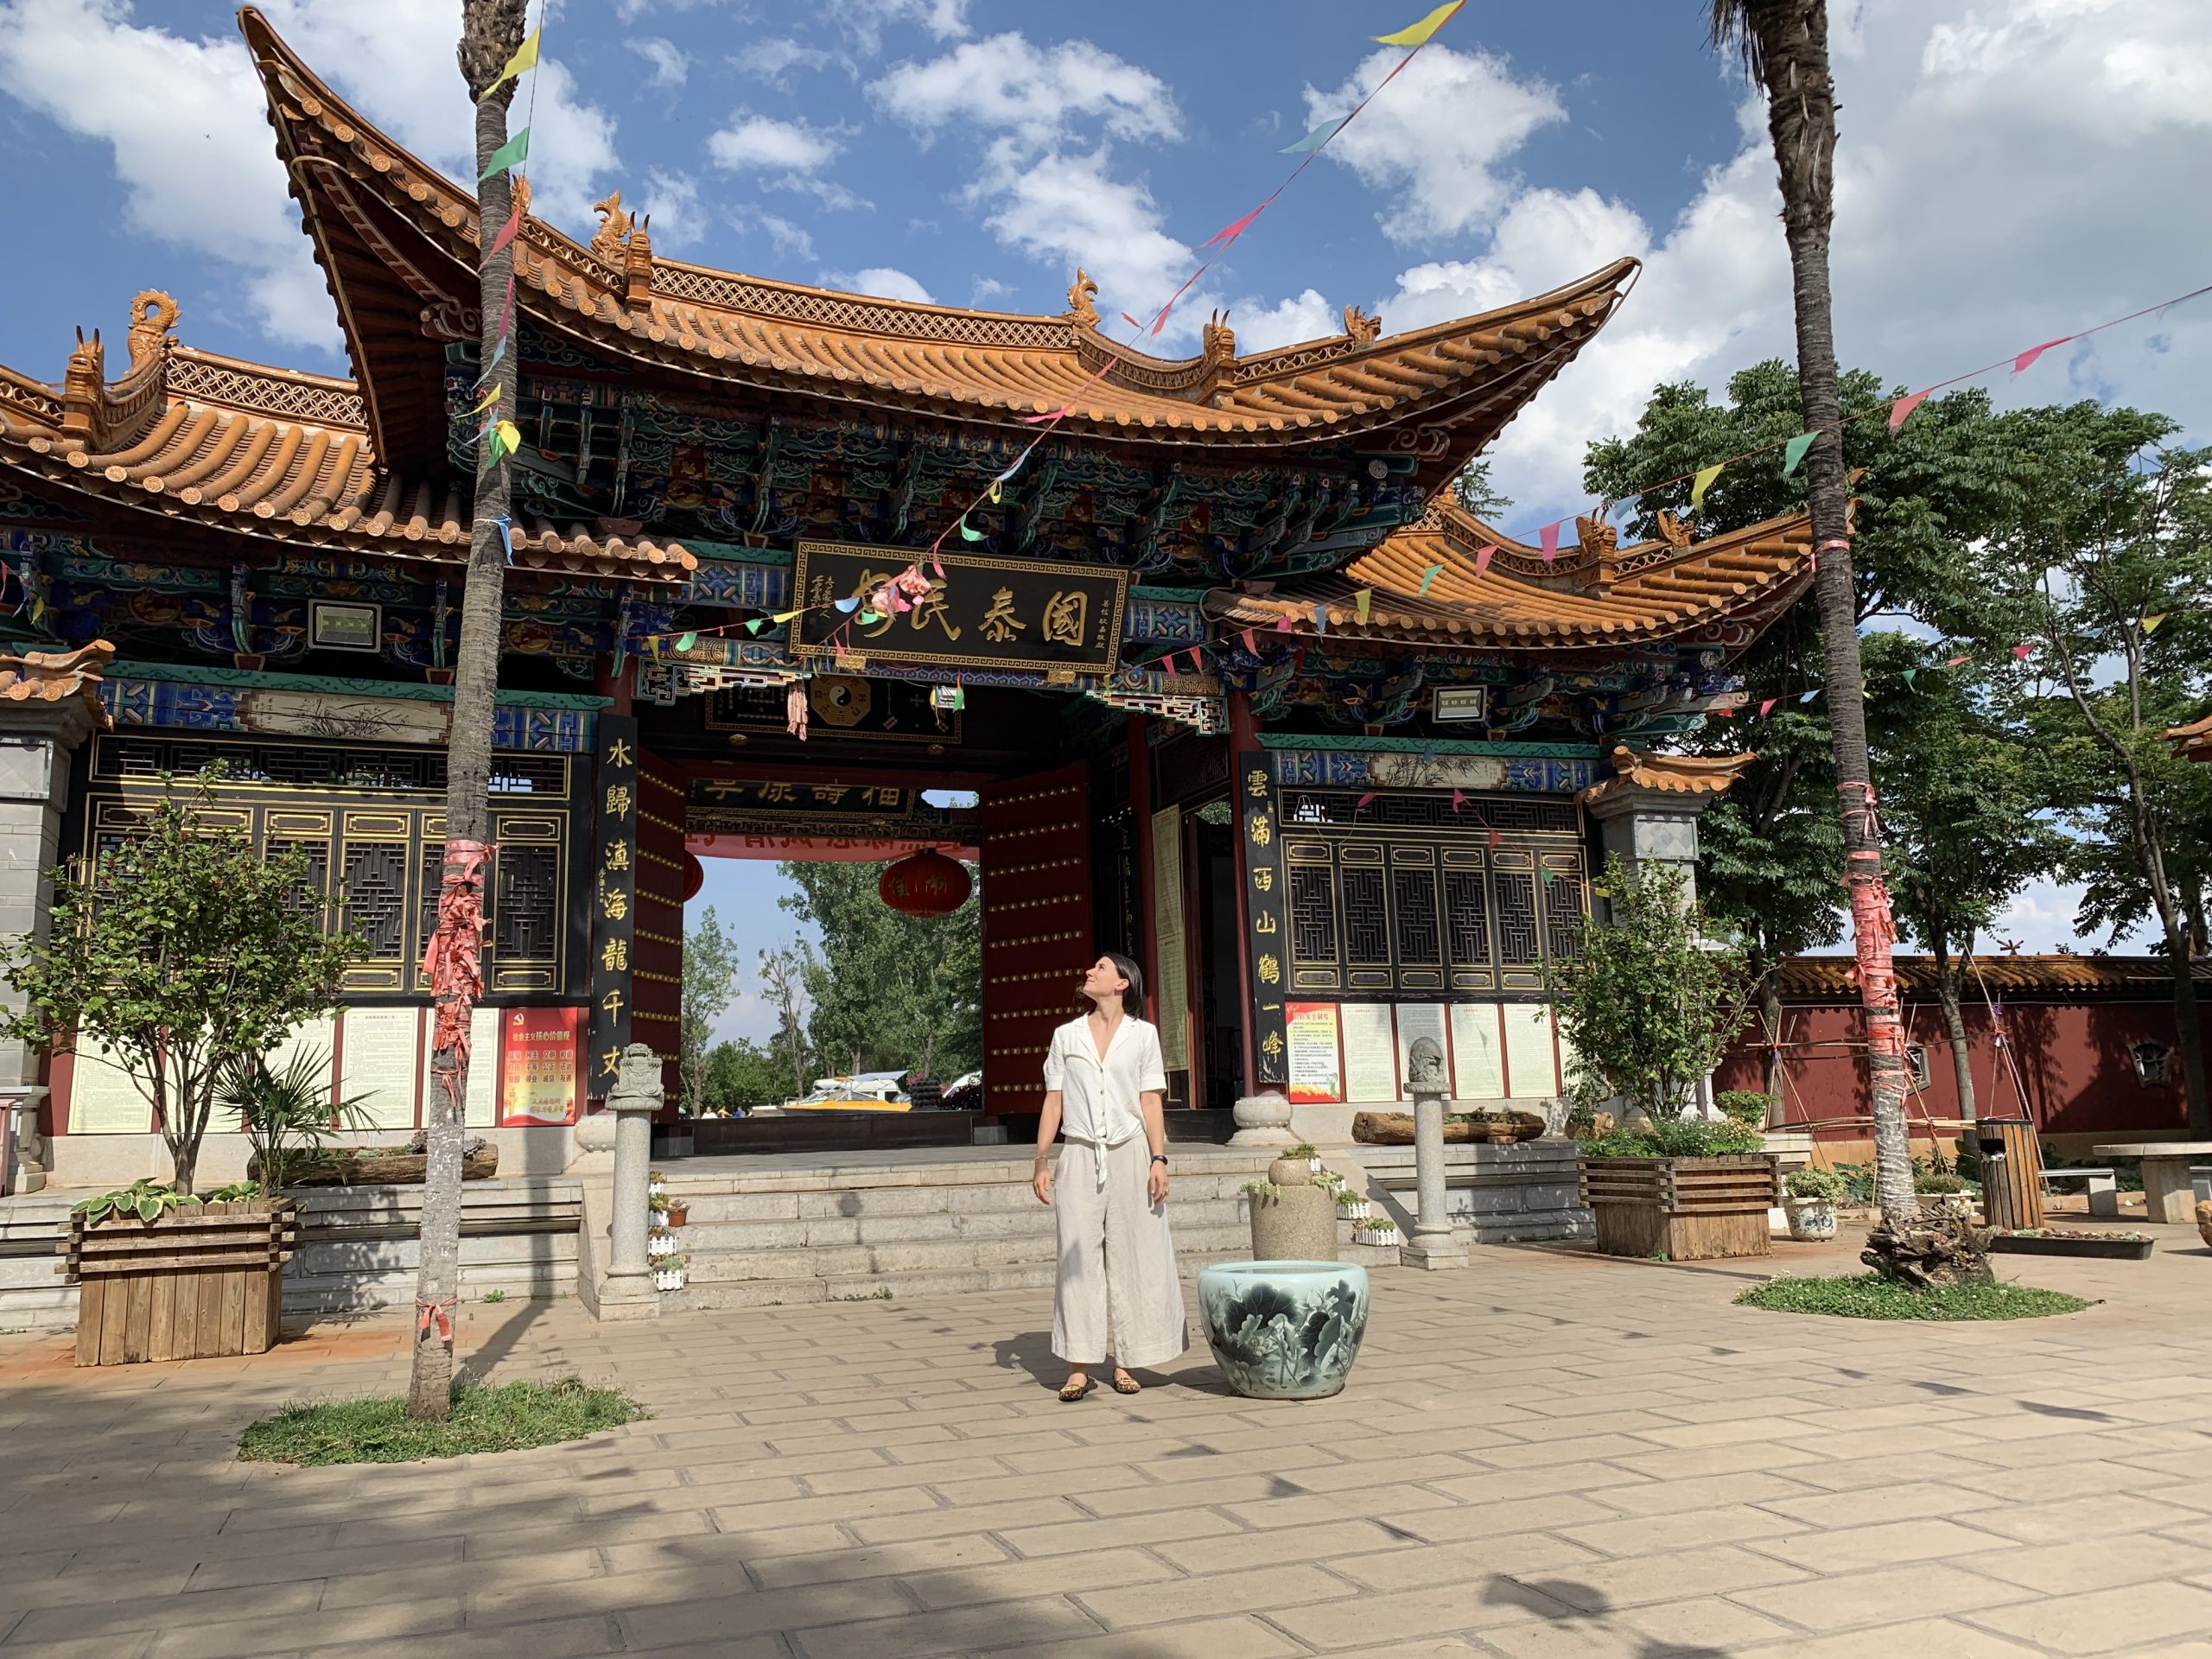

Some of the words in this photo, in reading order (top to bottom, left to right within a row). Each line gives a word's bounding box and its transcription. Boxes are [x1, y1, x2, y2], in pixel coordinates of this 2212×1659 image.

[512, 1031, 570, 1042] 社会主义核心价值观
[526, 1051, 538, 1059] 民主
[543, 1051, 556, 1059] 文明
